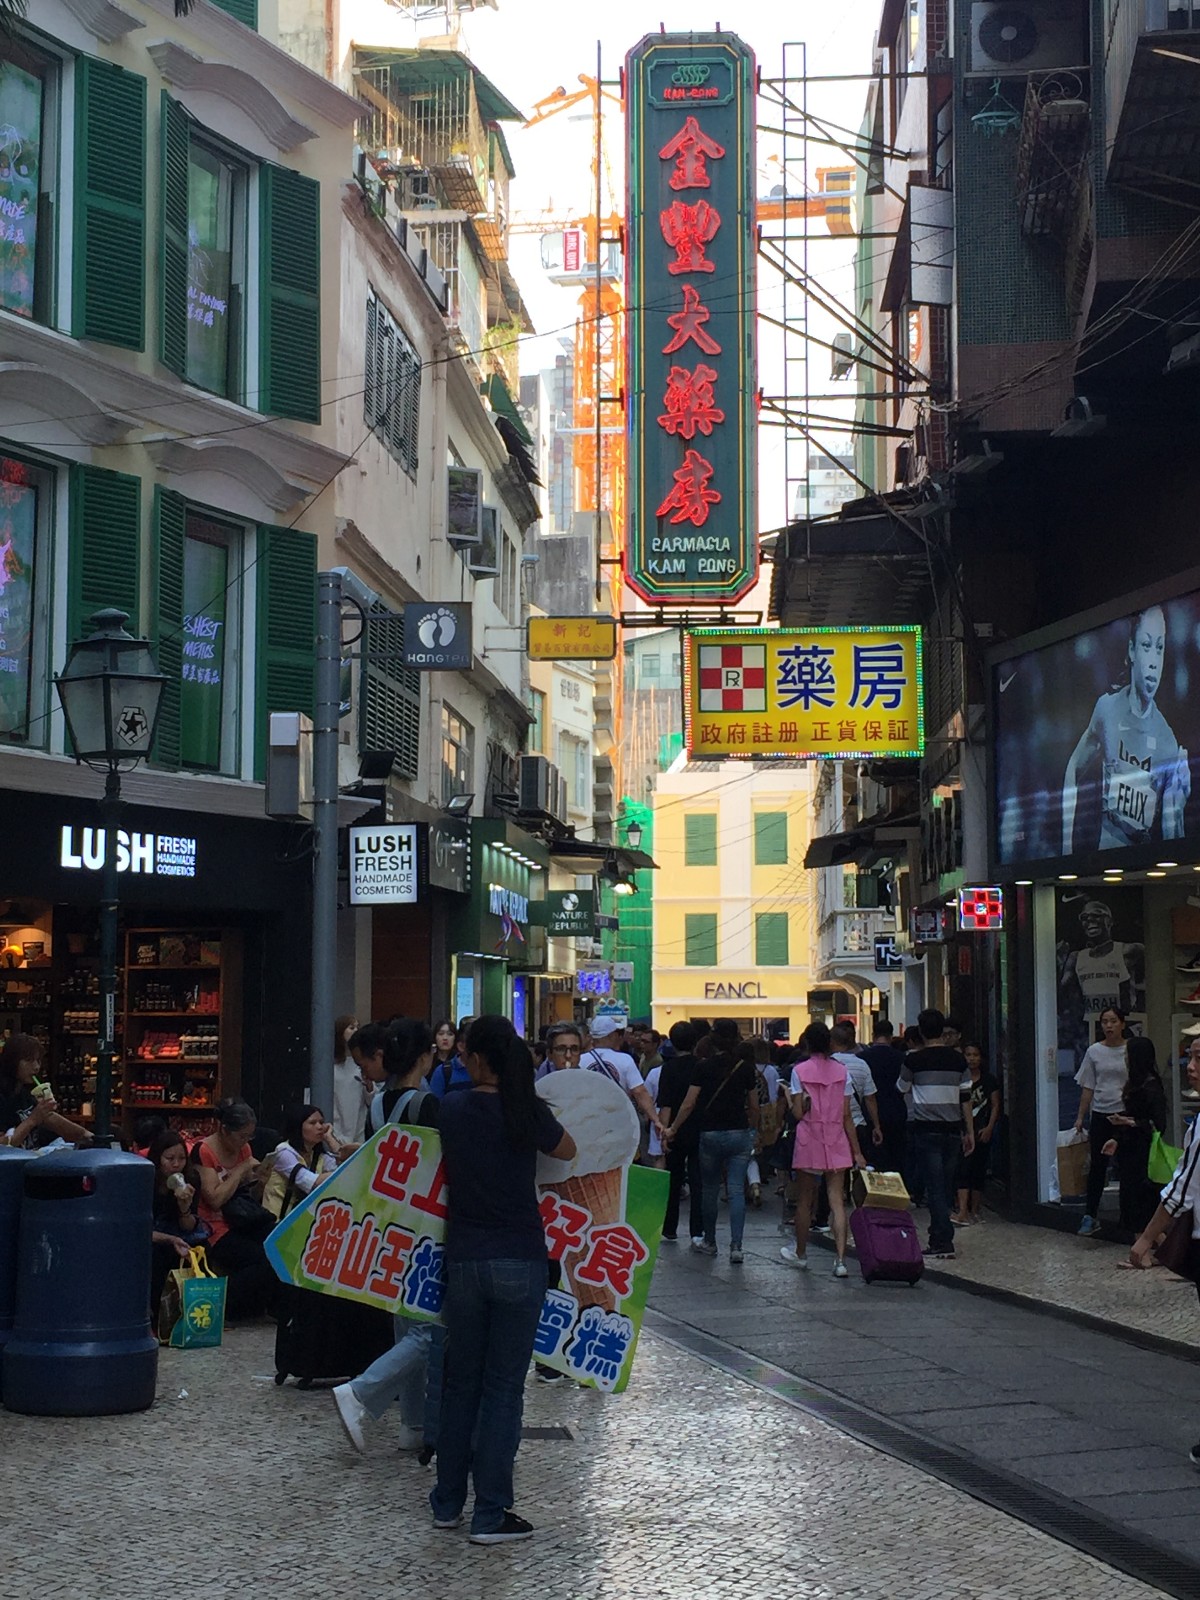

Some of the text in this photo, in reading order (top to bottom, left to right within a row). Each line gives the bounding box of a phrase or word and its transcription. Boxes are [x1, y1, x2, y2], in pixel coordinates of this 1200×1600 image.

[648, 558, 737, 573] KAM PONG
[777, 643, 908, 710] 藥房
[1117, 782, 1149, 825] FELIX
[61, 826, 154, 874] LUSH
[157, 835, 196, 855] FRESH
[354, 834, 412, 853] LUSH
[157, 864, 196, 877] COSMETICS
[354, 855, 412, 872] FRESH
[354, 873, 413, 884] HANDMADE
[354, 885, 413, 896] COSMETICS
[552, 911, 589, 920] NATURE
[704, 981, 768, 999] FANCL
